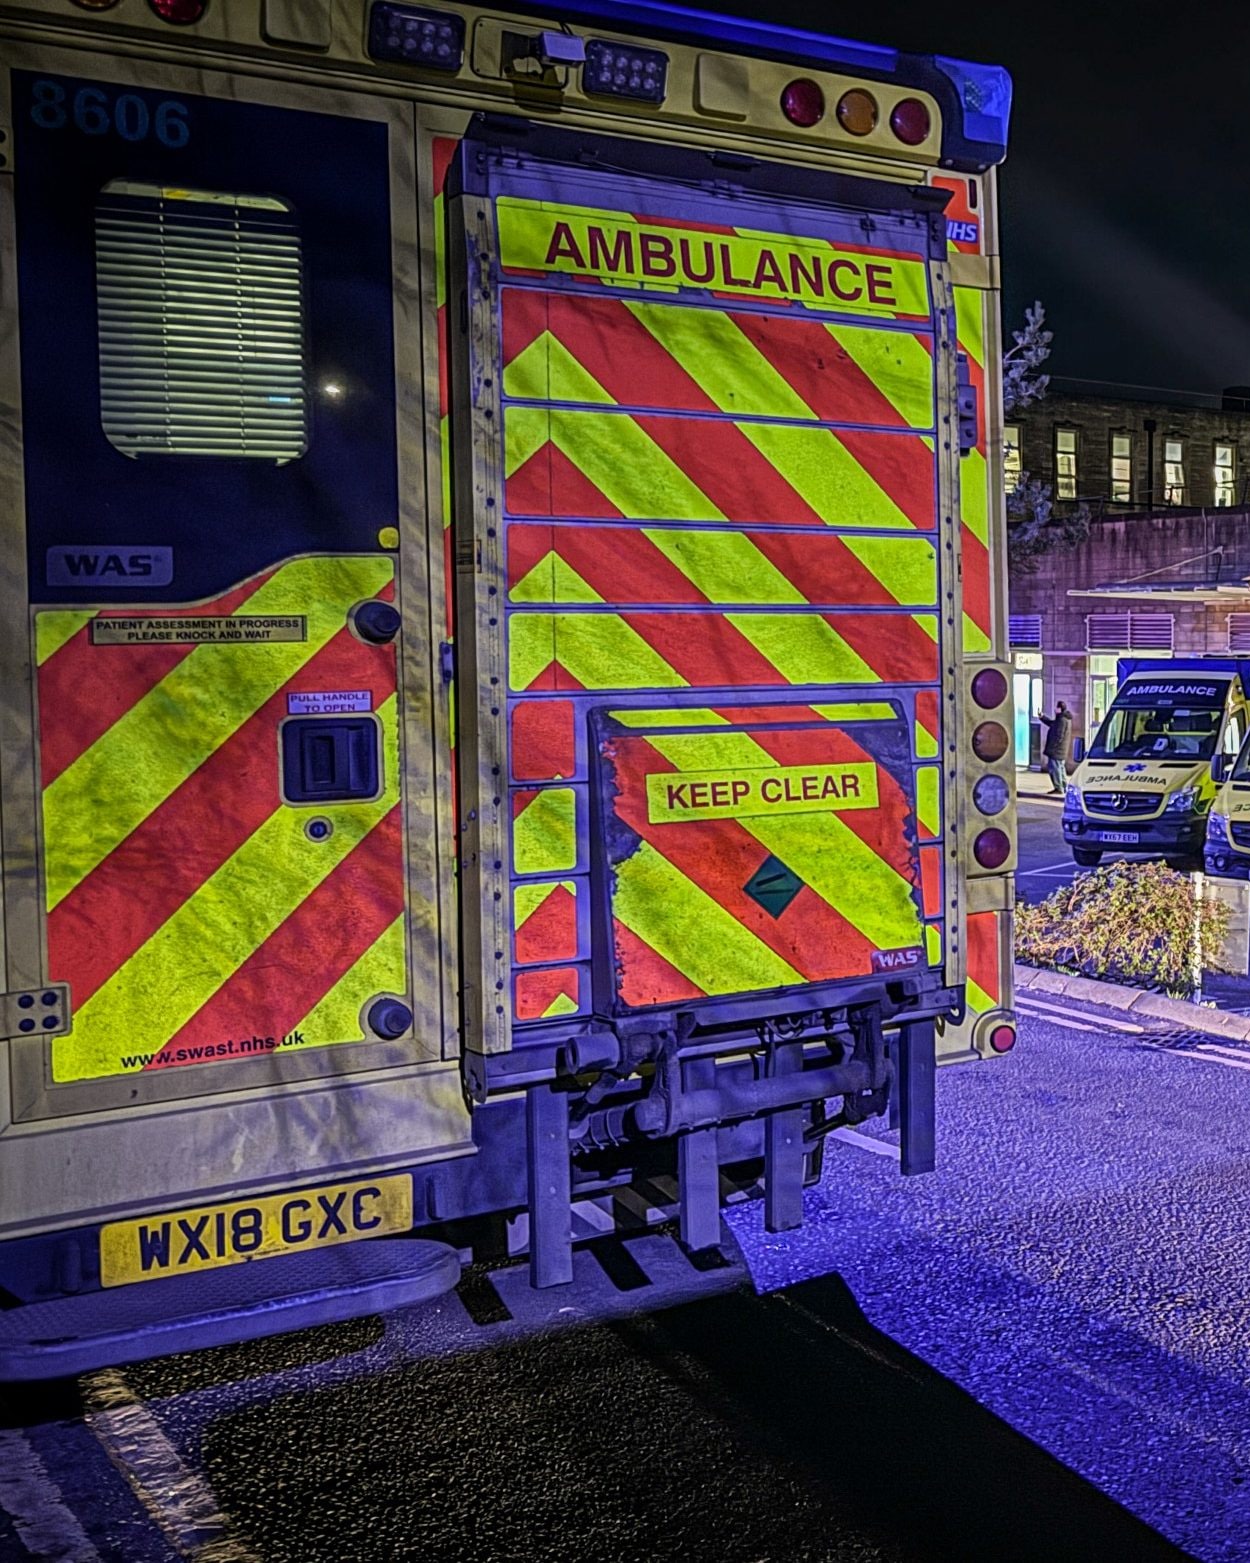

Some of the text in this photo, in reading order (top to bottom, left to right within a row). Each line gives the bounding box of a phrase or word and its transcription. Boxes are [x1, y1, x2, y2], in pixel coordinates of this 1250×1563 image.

[30, 79, 190, 148] 8606
[545, 222, 897, 306] AMBULANCE
[64, 554, 152, 577] WAS
[96, 619, 299, 630] PATIENT ASSESSMENT IN PROGRESS
[128, 630, 271, 641] PLEASE KNOCK AND WAIT
[290, 692, 368, 702] PULL HANDLE
[1126, 684, 1217, 697] AMBULANCE
[304, 703, 356, 712] TO OPEN
[666, 773, 861, 810] KEEP CLEAR
[878, 950, 918, 967] WAS
[121, 1031, 305, 1069] www.swast.nhs.uk
[138, 1187, 382, 1272] WX18 GXC
